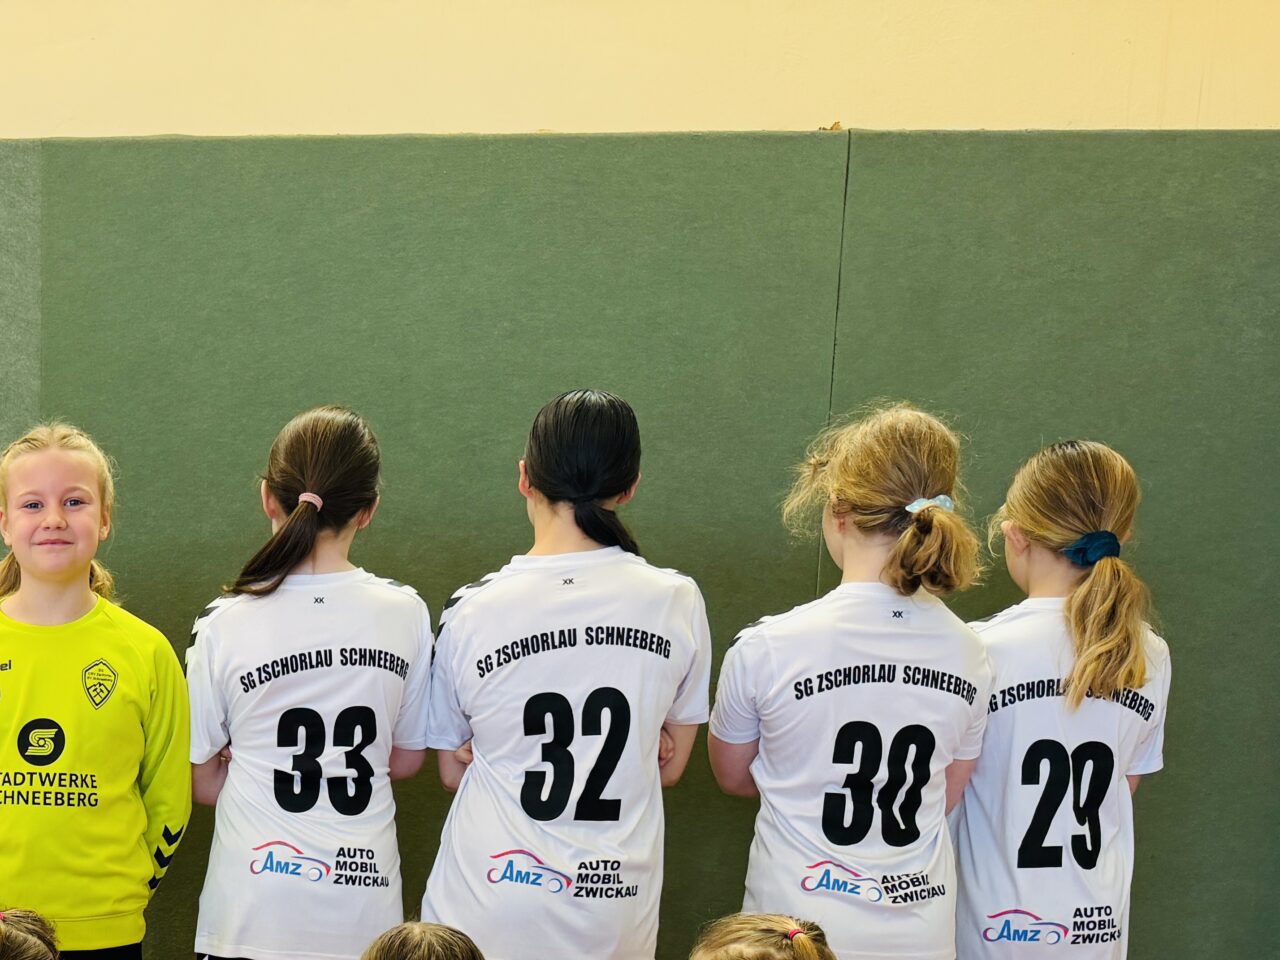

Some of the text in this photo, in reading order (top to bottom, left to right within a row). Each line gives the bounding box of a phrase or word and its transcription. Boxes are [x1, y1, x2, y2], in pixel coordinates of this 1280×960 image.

[476, 626, 671, 678] SG ZSCHORLAU SCHNEEBERG
[240, 648, 409, 693] SG ZSCHORLAU SCHNEEBERG
[794, 664, 977, 706] SG ZSCHORLAU SCHNEEBERG
[274, 706, 377, 816] 33
[520, 687, 631, 821] 32
[822, 721, 936, 847] 30
[1017, 739, 1114, 870] 29
[336, 847, 375, 860] AUTO
[335, 860, 379, 874] MOBIL
[577, 860, 620, 871] AUTO
[333, 873, 389, 888] ZWICKAU
[576, 873, 623, 885] MOBIL
[573, 885, 638, 899] ZWICKAU
[1072, 905, 1112, 919] AUTO
[1072, 918, 1117, 932] MOBIL
